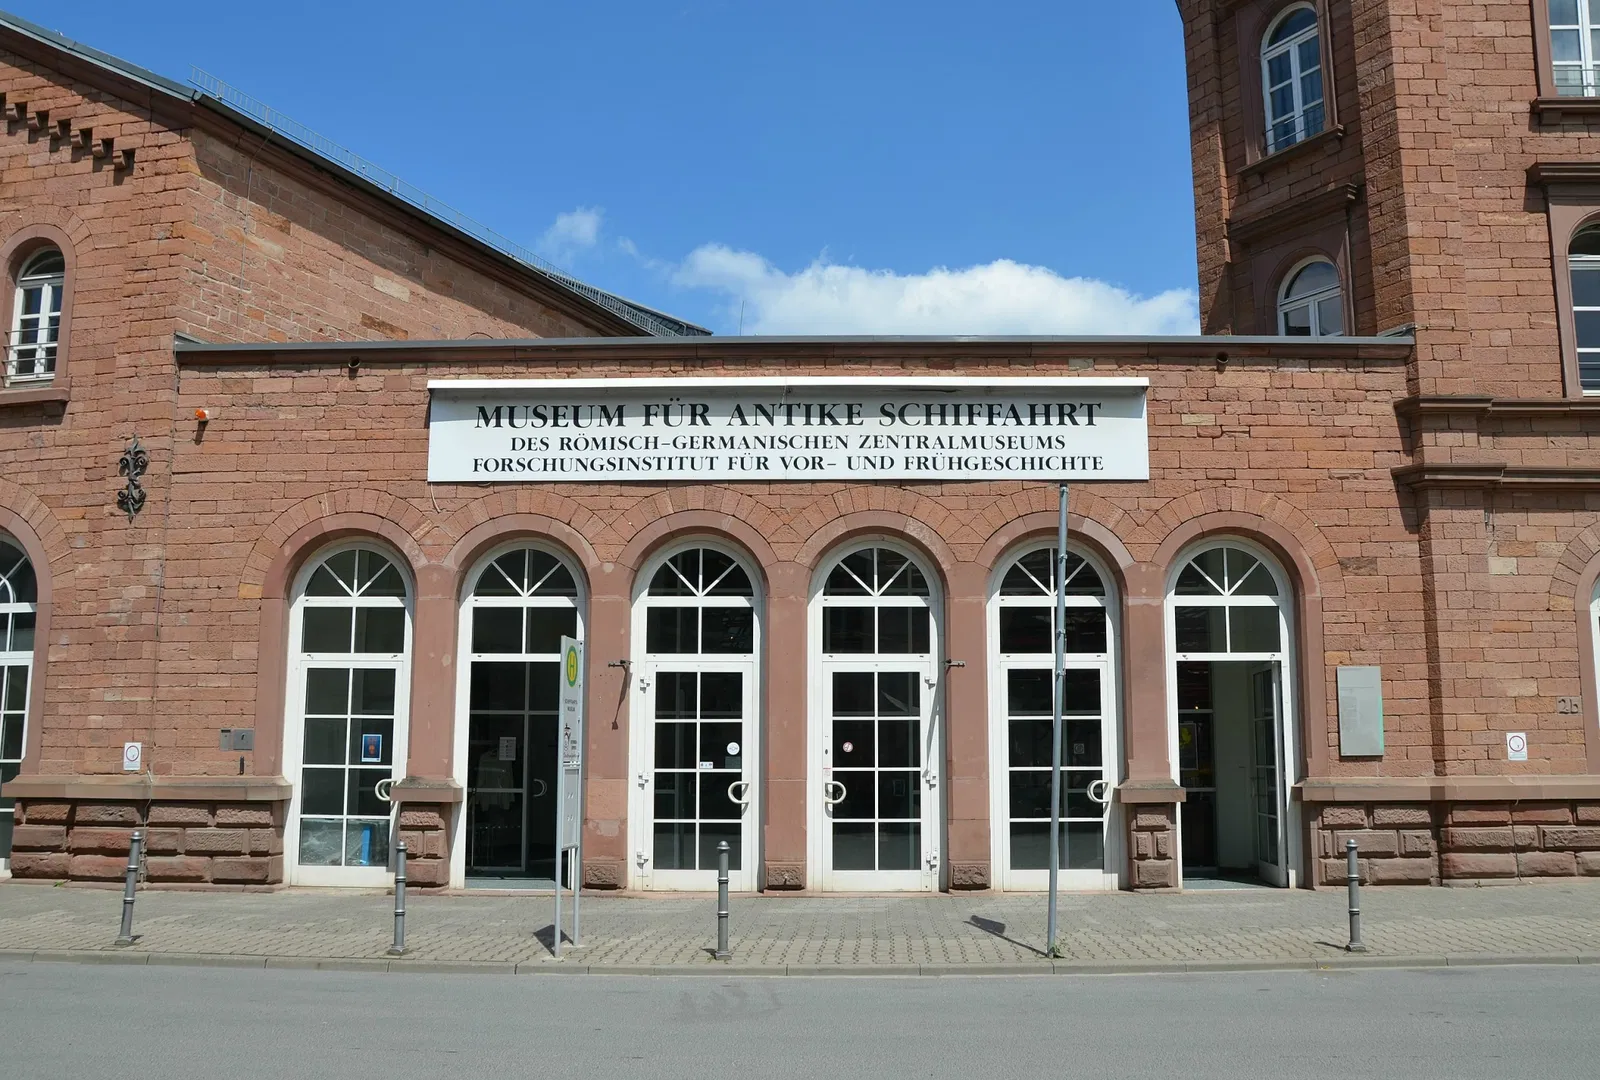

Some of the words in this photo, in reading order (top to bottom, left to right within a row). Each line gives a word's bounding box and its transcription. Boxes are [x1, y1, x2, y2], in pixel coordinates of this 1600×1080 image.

[474, 404, 626, 429] MUSEUM
[641, 397, 712, 427] FÜR
[726, 402, 864, 427] ANTIKE
[878, 401, 1103, 427] SCHIFFAHRT
[511, 437, 549, 451] DES
[558, 432, 849, 451] RÖMISCH-GERMANISCHEN
[858, 435, 1066, 450] ZENTRALMUSEUMS
[472, 456, 719, 473] FORSCHUNGSINSTITUT
[727, 452, 770, 471] FÜR
[779, 455, 837, 471] VOR-
[847, 455, 895, 471] UND
[904, 451, 1104, 471] FRÜHGESCHICHTE
